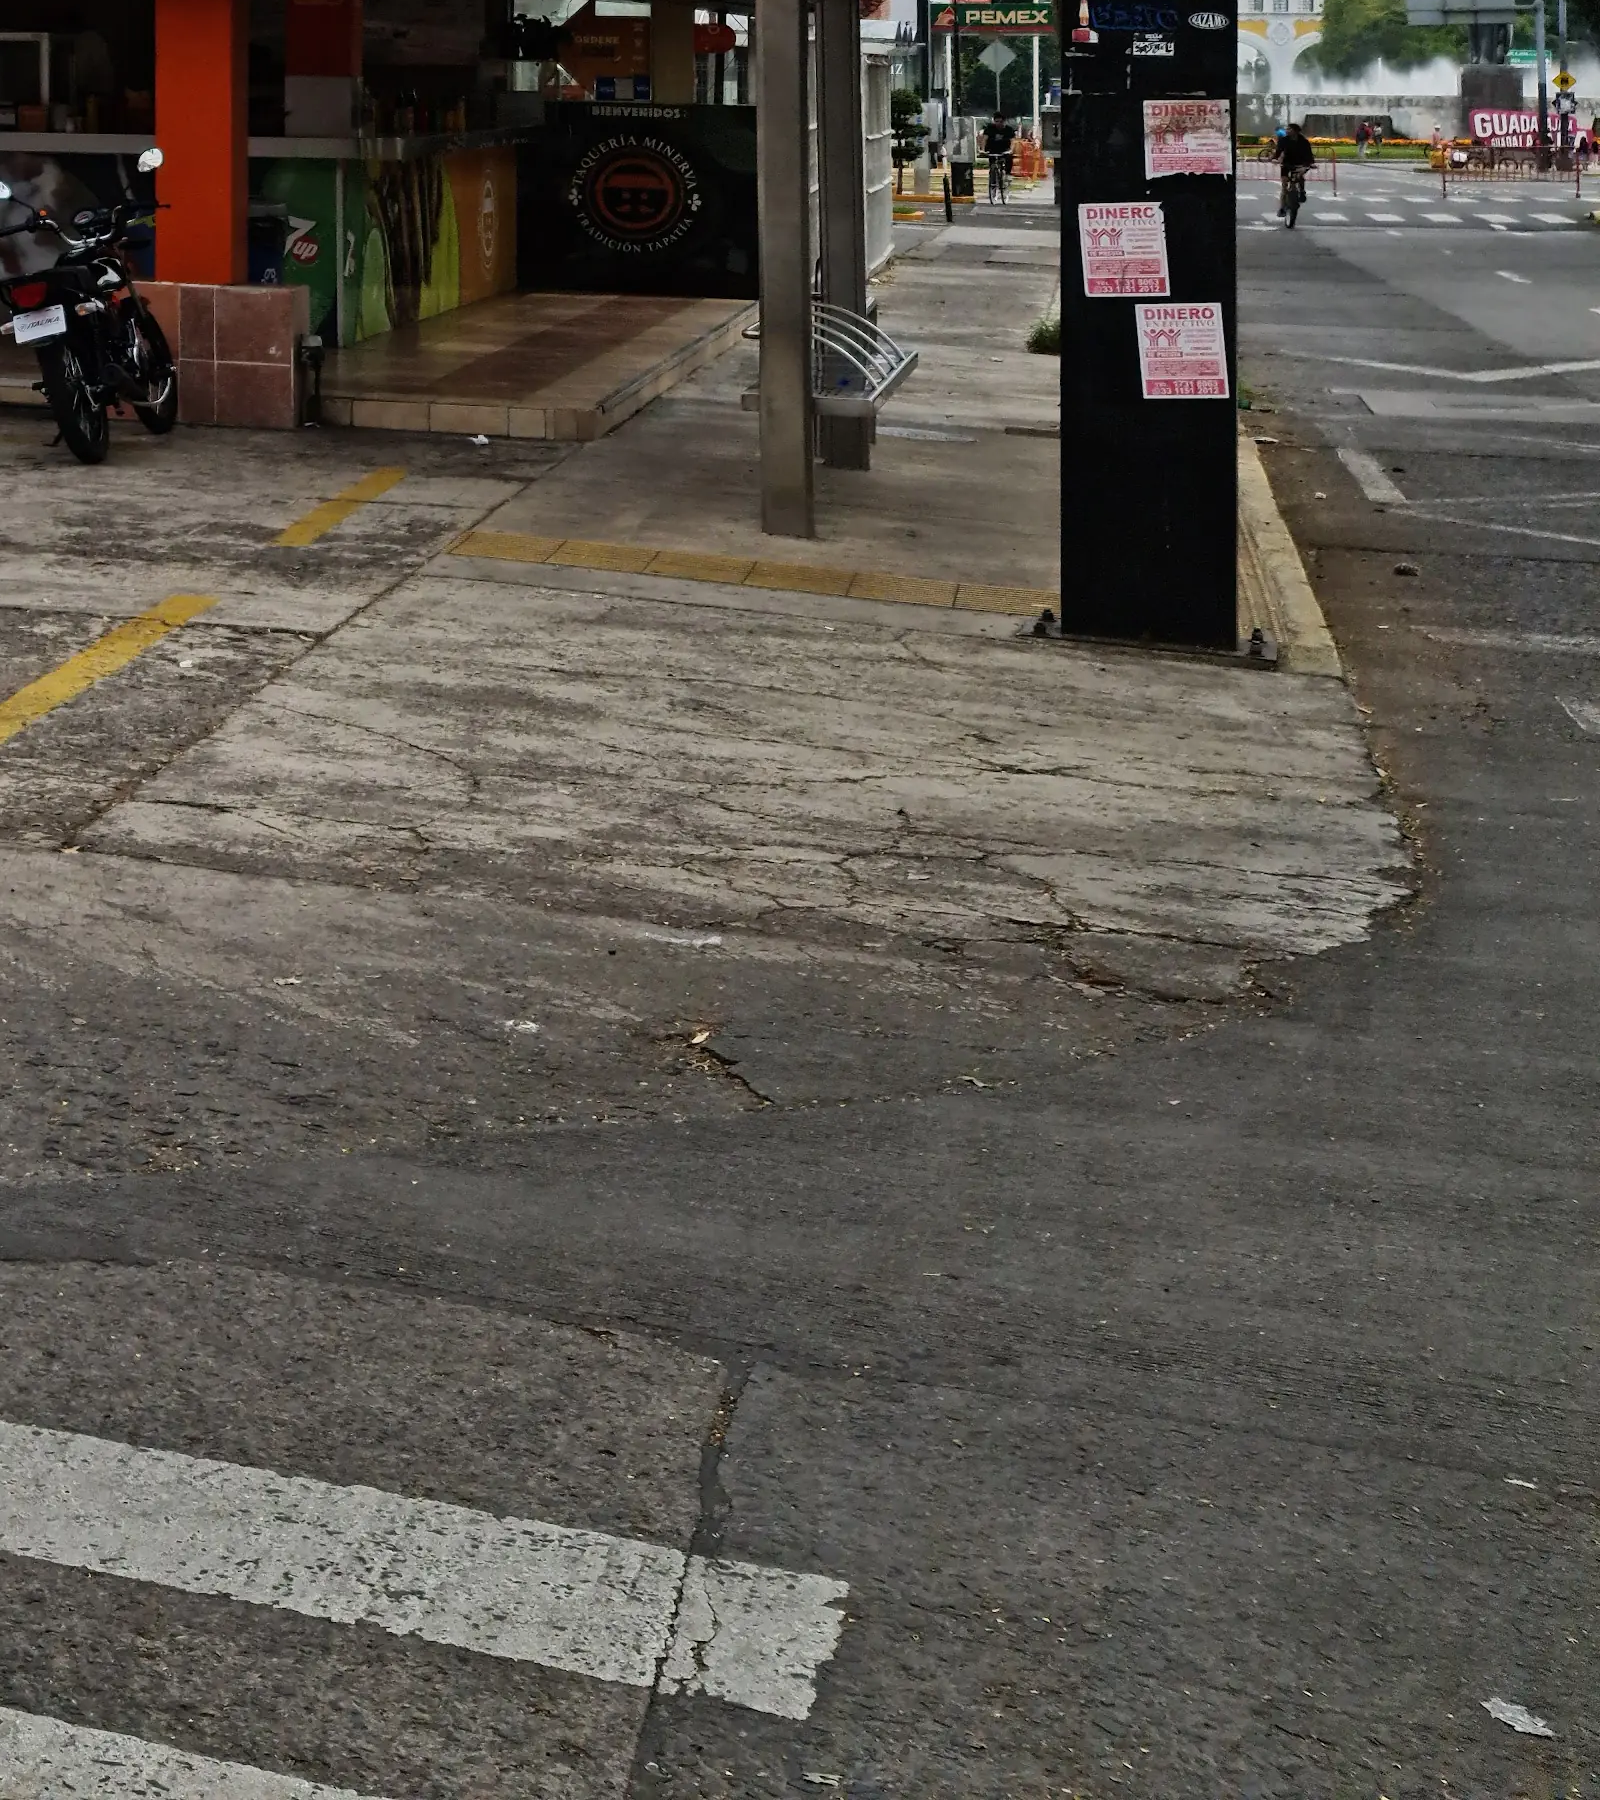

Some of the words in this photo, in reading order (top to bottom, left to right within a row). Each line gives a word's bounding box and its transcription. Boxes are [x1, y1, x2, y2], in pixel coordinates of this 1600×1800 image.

[965, 10, 1049, 24] PEMEX
[591, 105, 681, 118] BIENVENIDOS
[1151, 104, 1221, 116] DINERO
[572, 134, 637, 186] TAQUERÍA
[642, 136, 698, 190] MINERVA
[284, 215, 320, 263] 7up
[576, 211, 642, 253] TRADICIÓN
[646, 217, 693, 252] TAPATÍA
[1143, 307, 1215, 320] DINERO
[26, 315, 60, 330] ITALIKA
